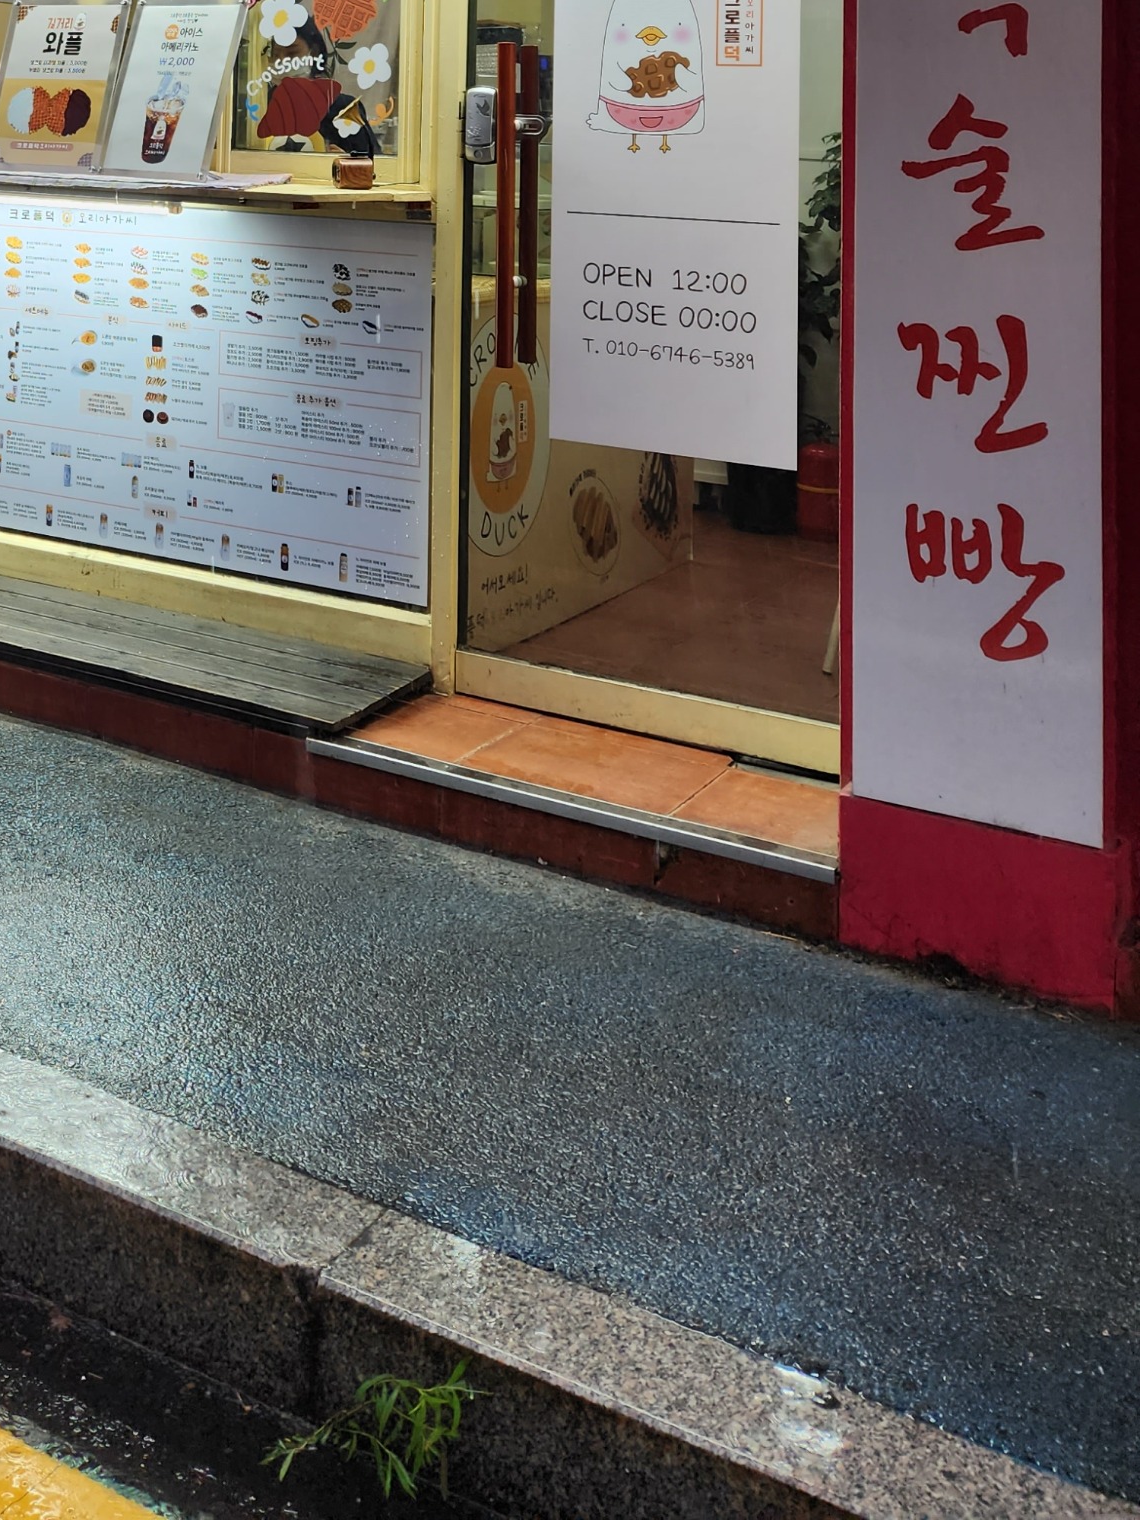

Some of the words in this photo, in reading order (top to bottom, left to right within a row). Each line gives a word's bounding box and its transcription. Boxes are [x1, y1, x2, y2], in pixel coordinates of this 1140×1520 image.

[42, 31, 84, 56] 와플
[161, 41, 200, 53] 아메리카노
[179, 27, 204, 38] 아이스
[246, 53, 325, 97] Croissant
[10, 208, 55, 223] 크로플덕
[79, 212, 138, 226] 오리아가씨
[582, 262, 653, 288] OPEN
[671, 269, 748, 296] 12:00
[582, 300, 668, 327] CLOSE
[678, 306, 757, 334] 00:00
[582, 338, 600, 355] T.
[605, 339, 755, 371] 010-6746-5389
[481, 504, 529, 546] DUCK
[481, 563, 529, 594] 어서오세요!
